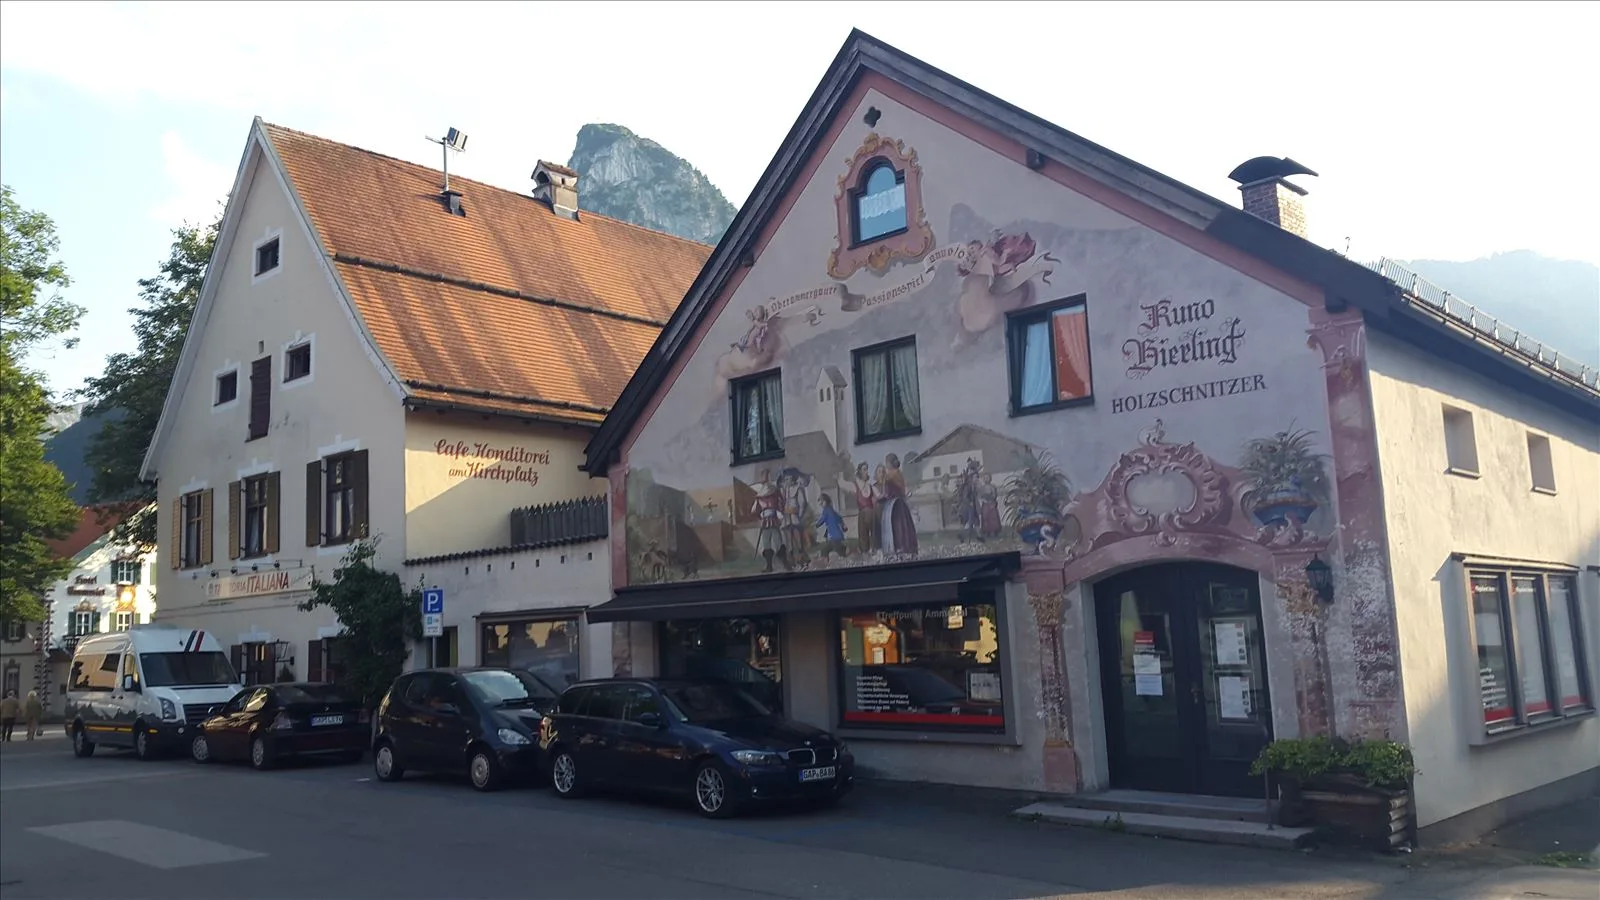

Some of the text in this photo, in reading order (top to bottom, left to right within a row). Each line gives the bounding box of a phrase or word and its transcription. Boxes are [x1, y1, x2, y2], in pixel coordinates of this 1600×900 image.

[1138, 298, 1215, 332] Kuno
[1122, 318, 1246, 376] Bierling
[1111, 374, 1267, 415] HOLZSCHNITZER
[434, 438, 551, 465] Cafe Konditorei
[448, 461, 540, 488] am Kirchplatz
[246, 571, 289, 593] ITALIANA
[427, 592, 439, 612] P
[803, 768, 817, 779] GAP
